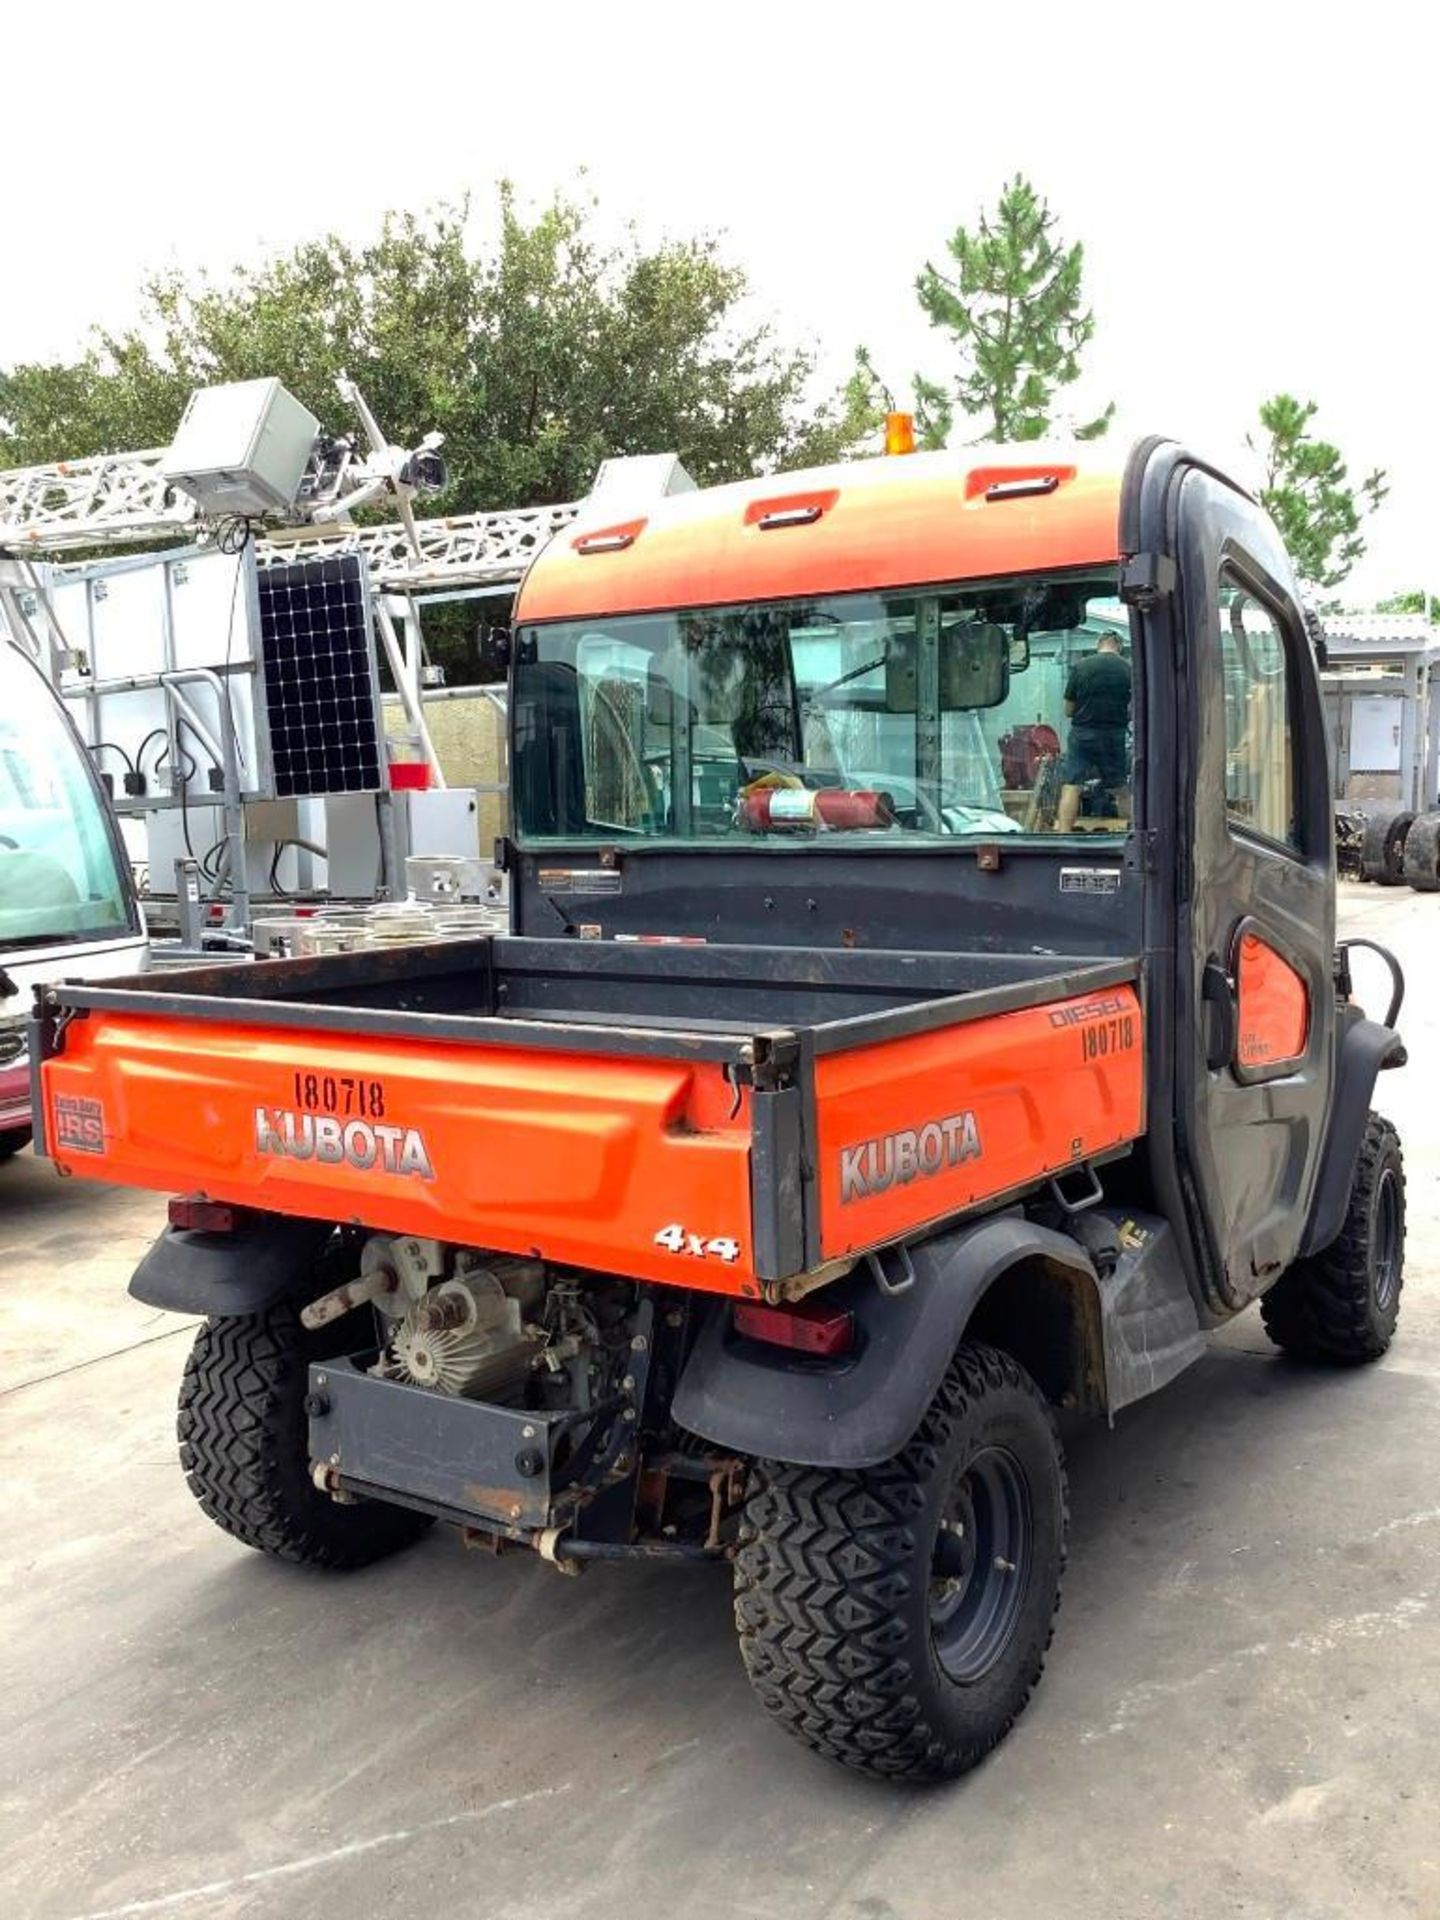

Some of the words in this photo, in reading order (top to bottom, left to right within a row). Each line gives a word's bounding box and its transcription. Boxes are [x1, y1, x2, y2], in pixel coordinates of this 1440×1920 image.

[1049, 996, 1131, 1028] DIESEL
[1081, 1016, 1132, 1063] 180718
[295, 1072, 385, 1118] 180718
[58, 1113, 101, 1142] IRS
[255, 1107, 434, 1179] KUBOTA
[841, 1110, 982, 1206] KUBOTA
[653, 1223, 741, 1263] 4x4
